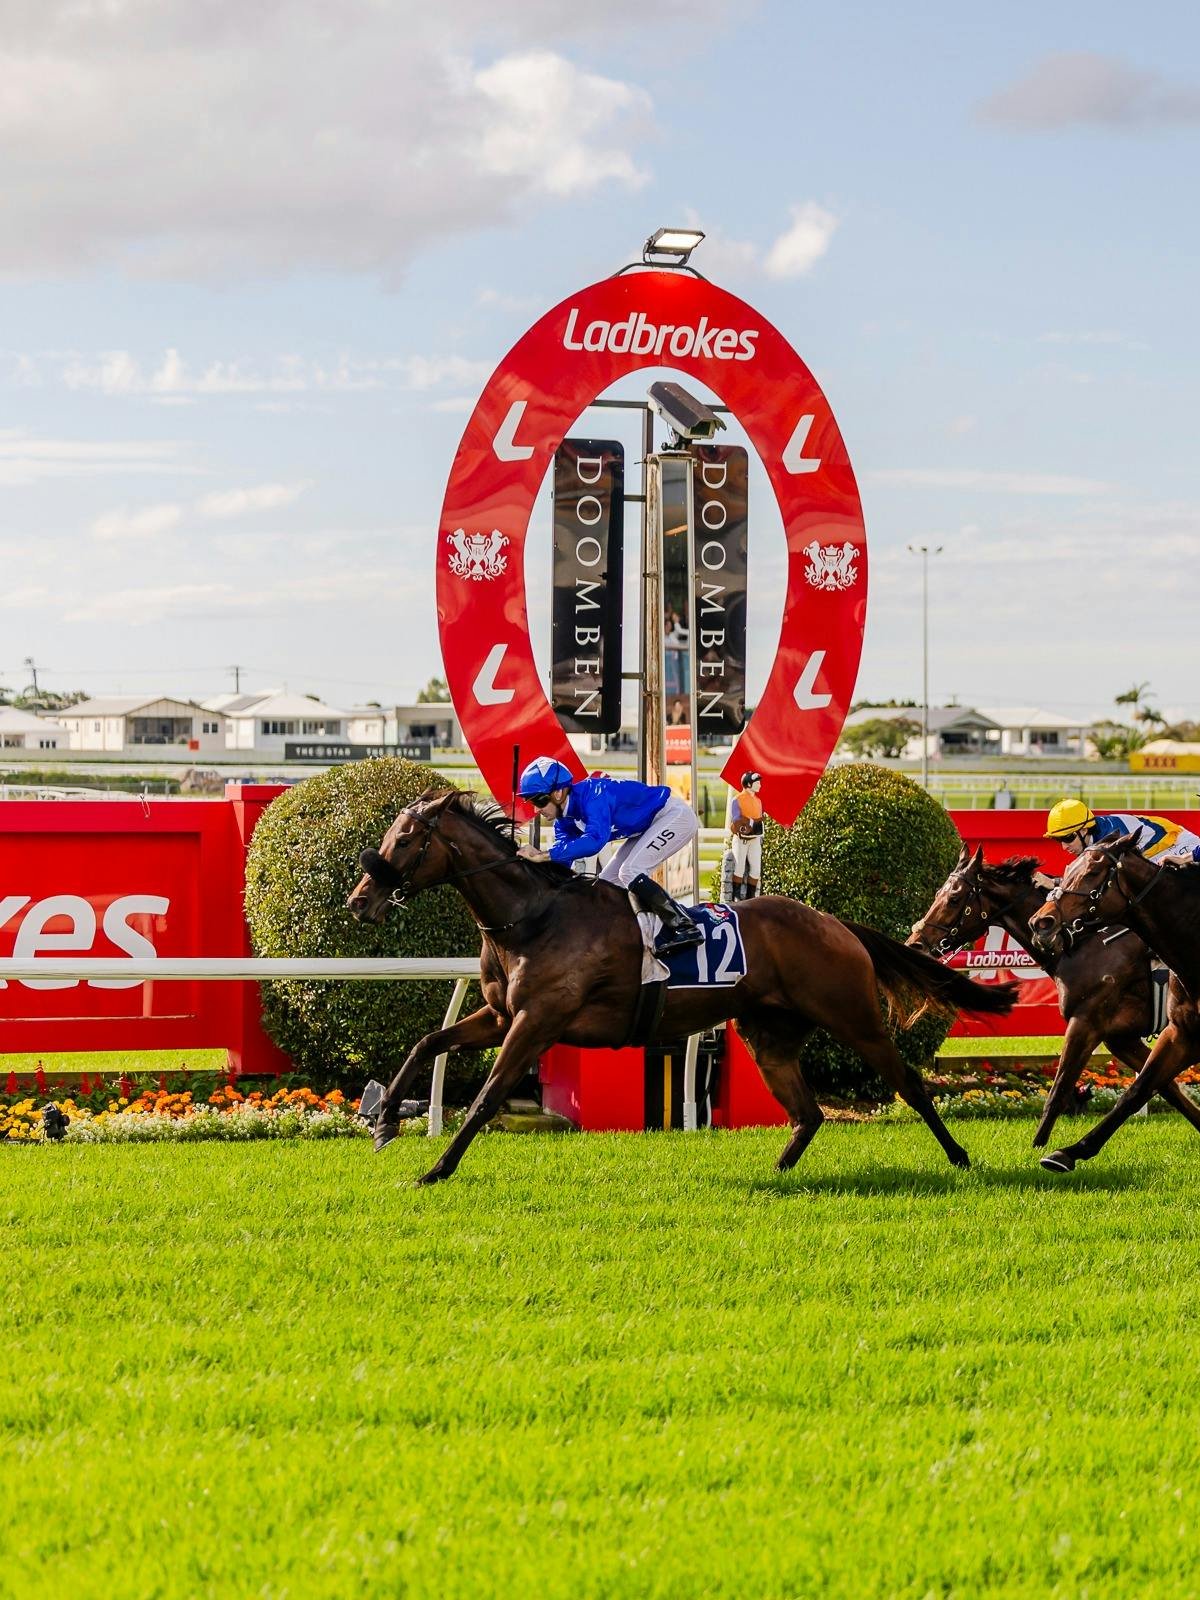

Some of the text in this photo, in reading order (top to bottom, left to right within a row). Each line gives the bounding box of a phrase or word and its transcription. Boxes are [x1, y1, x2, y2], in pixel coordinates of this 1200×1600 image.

[562, 308, 760, 361] Ladbrokes
[574, 455, 603, 718] DOOMBEN
[699, 461, 728, 720] DOOMBEN
[646, 828, 676, 851] TJS
[696, 921, 740, 983] 12
[966, 951, 1036, 967] Ladbrokes
